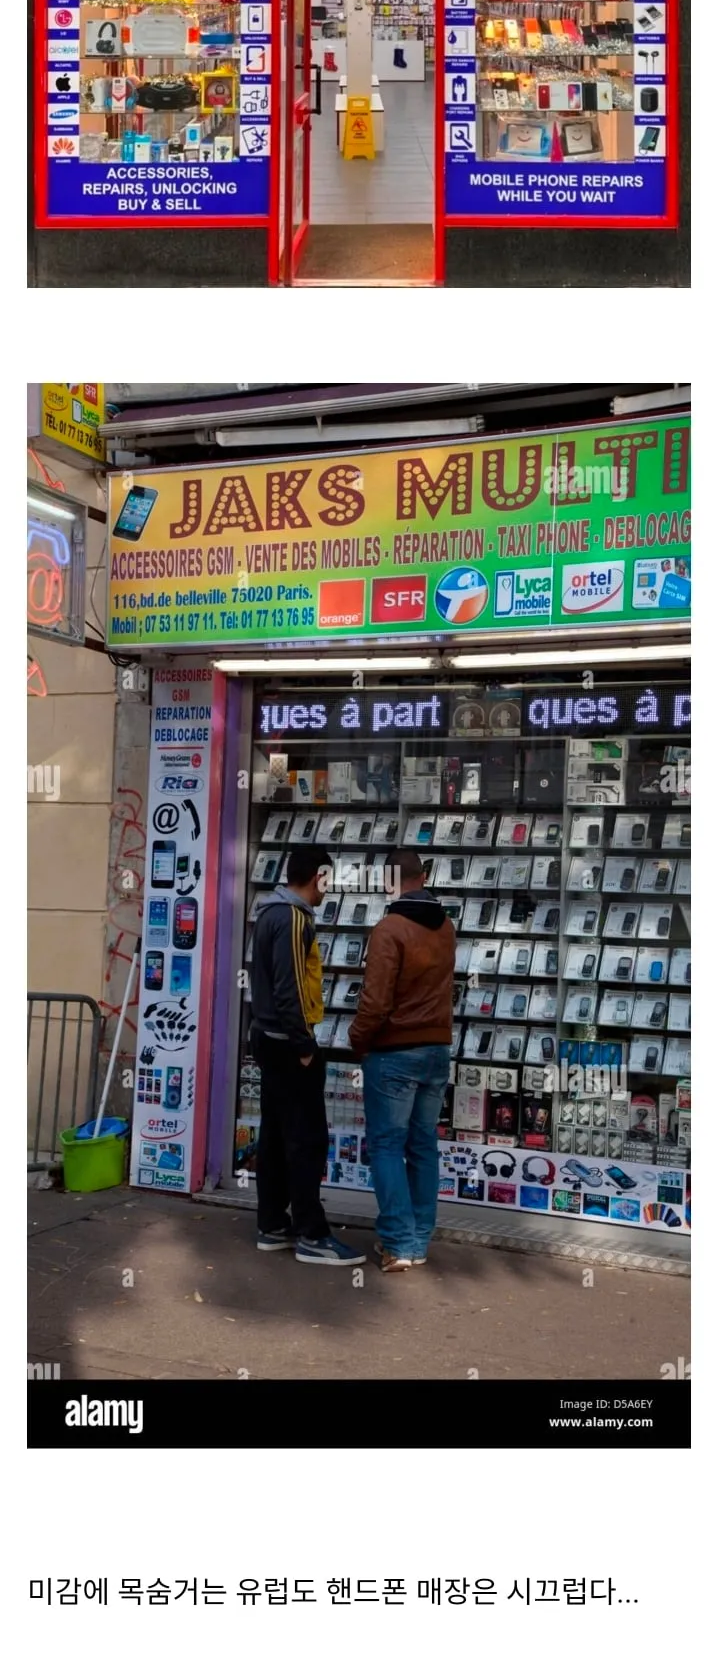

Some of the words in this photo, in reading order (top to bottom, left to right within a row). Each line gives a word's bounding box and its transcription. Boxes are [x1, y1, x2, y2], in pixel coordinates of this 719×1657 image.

[170, 464, 366, 540] JAKS
[396, 427, 691, 521] MULTI
[231, 585, 272, 604] 75020
[276, 584, 313, 601] Paris.
[383, 591, 425, 607] SFR
